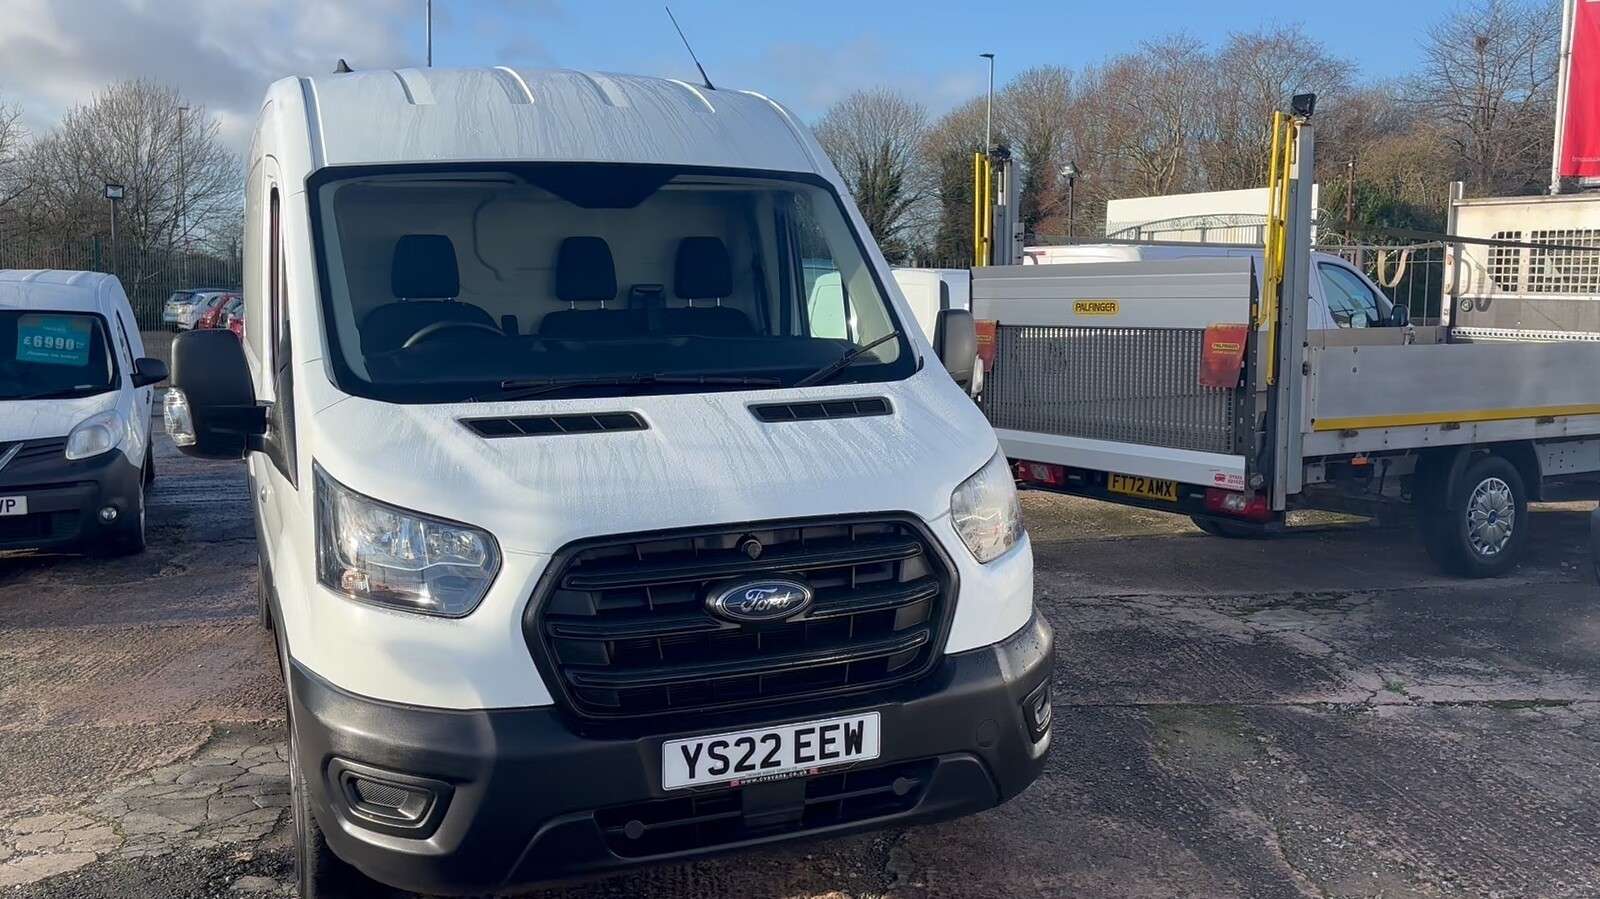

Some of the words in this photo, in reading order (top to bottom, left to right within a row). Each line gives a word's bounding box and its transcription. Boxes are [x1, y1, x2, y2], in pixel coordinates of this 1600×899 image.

[1075, 303, 1116, 312] PALFINGER
[1112, 474, 1145, 493] FT72
[1147, 480, 1172, 497] AMX
[741, 587, 791, 612] Ford
[681, 733, 781, 779] YS22
[794, 720, 864, 764] EEW
